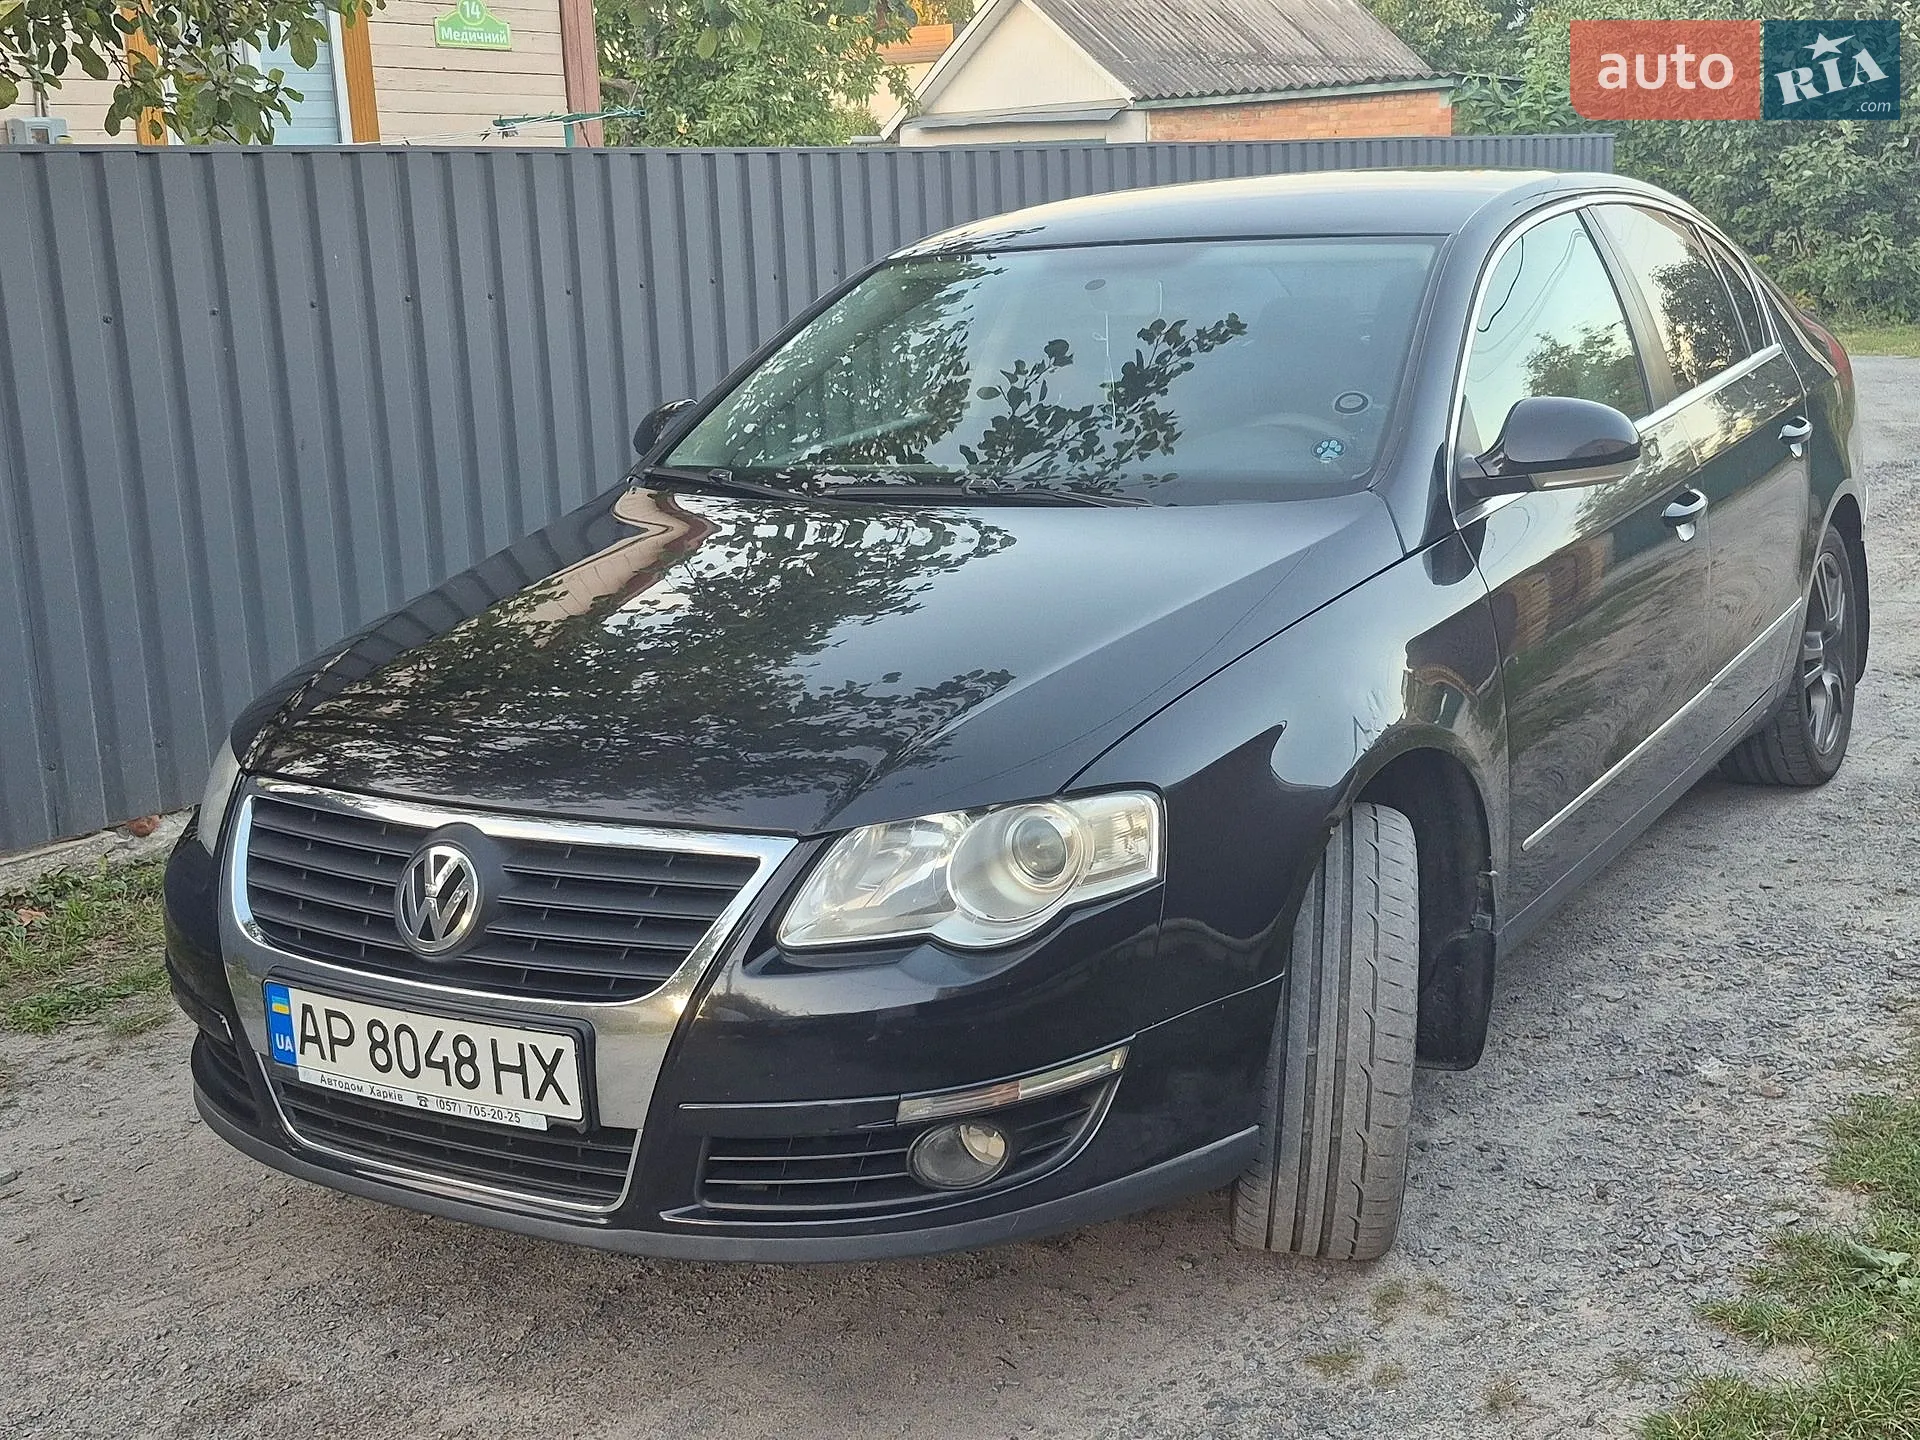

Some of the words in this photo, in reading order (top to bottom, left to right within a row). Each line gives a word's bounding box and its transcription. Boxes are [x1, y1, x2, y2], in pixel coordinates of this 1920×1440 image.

[463, 1, 480, 18] 14
[441, 26, 507, 43] Медичний
[275, 1032, 294, 1053] UA
[299, 1003, 355, 1063] AP
[366, 1019, 481, 1090] 8048
[490, 1038, 571, 1106] HX
[320, 1074, 364, 1093] Автодом
[369, 1085, 404, 1102] Харків
[435, 1099, 462, 1114] (057)
[467, 1104, 521, 1124] 705-20-25
